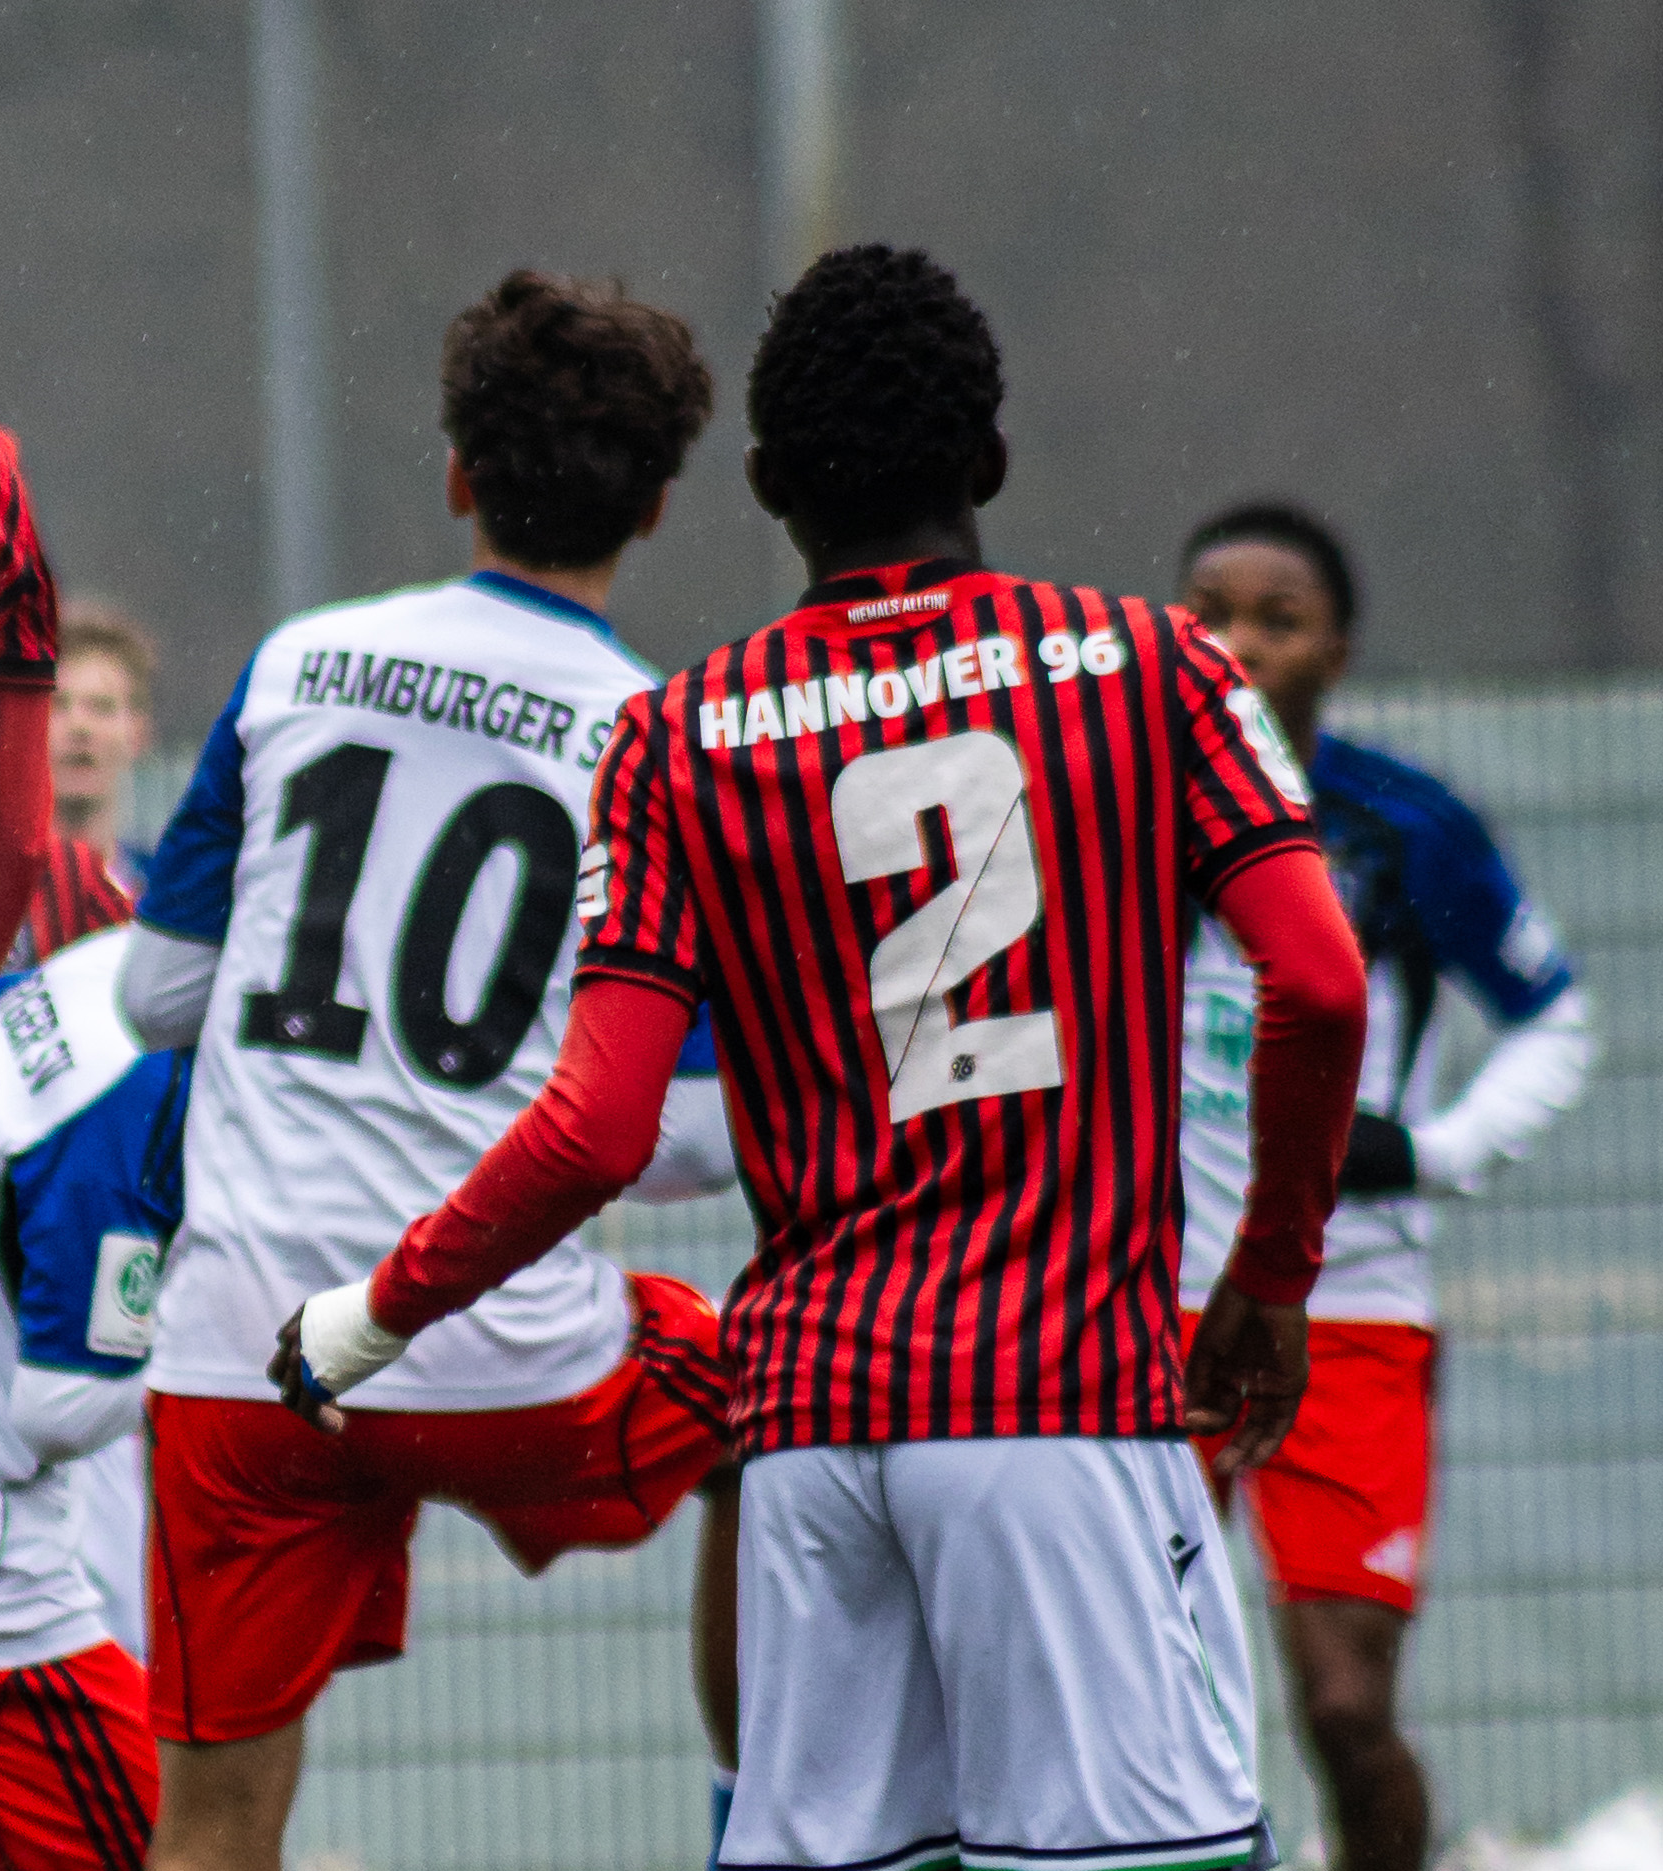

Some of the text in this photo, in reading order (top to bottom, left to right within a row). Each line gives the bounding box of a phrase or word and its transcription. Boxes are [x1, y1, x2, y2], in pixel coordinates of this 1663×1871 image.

[848, 598, 900, 625] NIEMALS
[290, 650, 577, 761] HAMBURGER
[698, 630, 1127, 750] HANNOVER 96
[237, 741, 580, 1092] 10
[831, 730, 1066, 1125] 2
